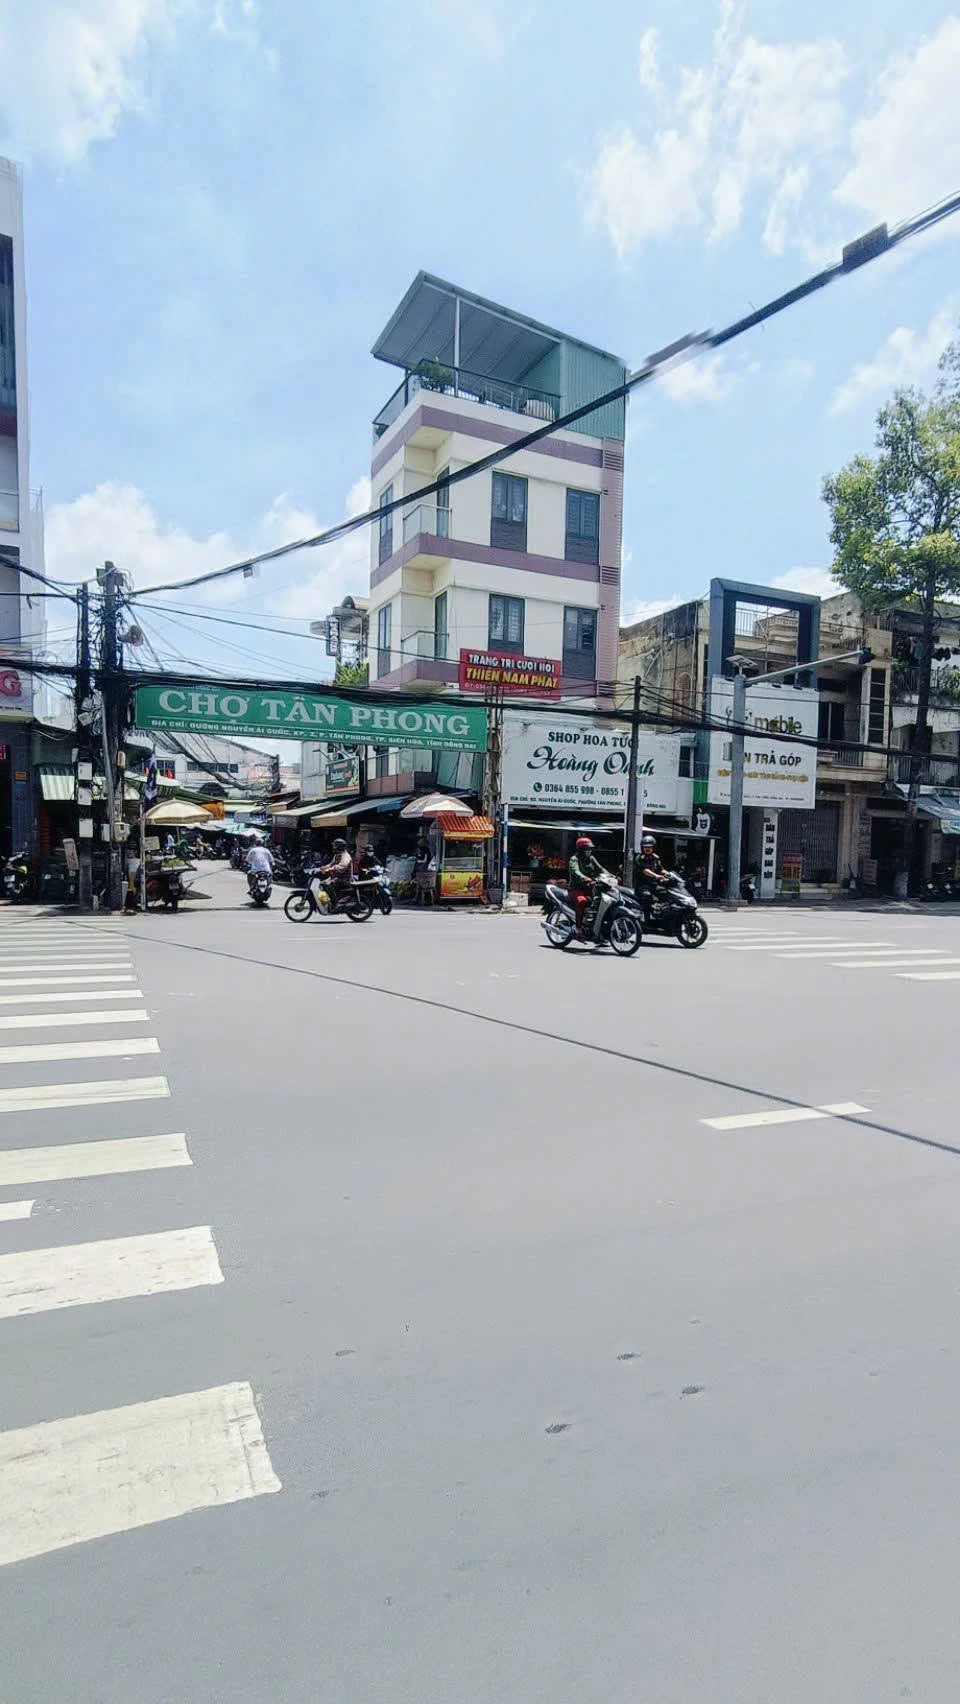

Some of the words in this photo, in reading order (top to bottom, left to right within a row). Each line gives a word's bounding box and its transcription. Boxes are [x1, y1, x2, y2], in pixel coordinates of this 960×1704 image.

[468, 654, 499, 667] TRANG
[502, 671, 529, 685] NAM
[159, 689, 250, 724] CHỢ
[260, 696, 338, 725] TÂN
[350, 706, 470, 736] PHONG
[754, 715, 802, 735] mobile
[548, 731, 580, 744] SHOP
[583, 734, 608, 747] HOA
[526, 745, 599, 782] Hoàng
[754, 750, 776, 765] TRẢ
[780, 752, 802, 766] GÓP
[565, 784, 579, 794] 855
[601, 787, 619, 796] 0855
